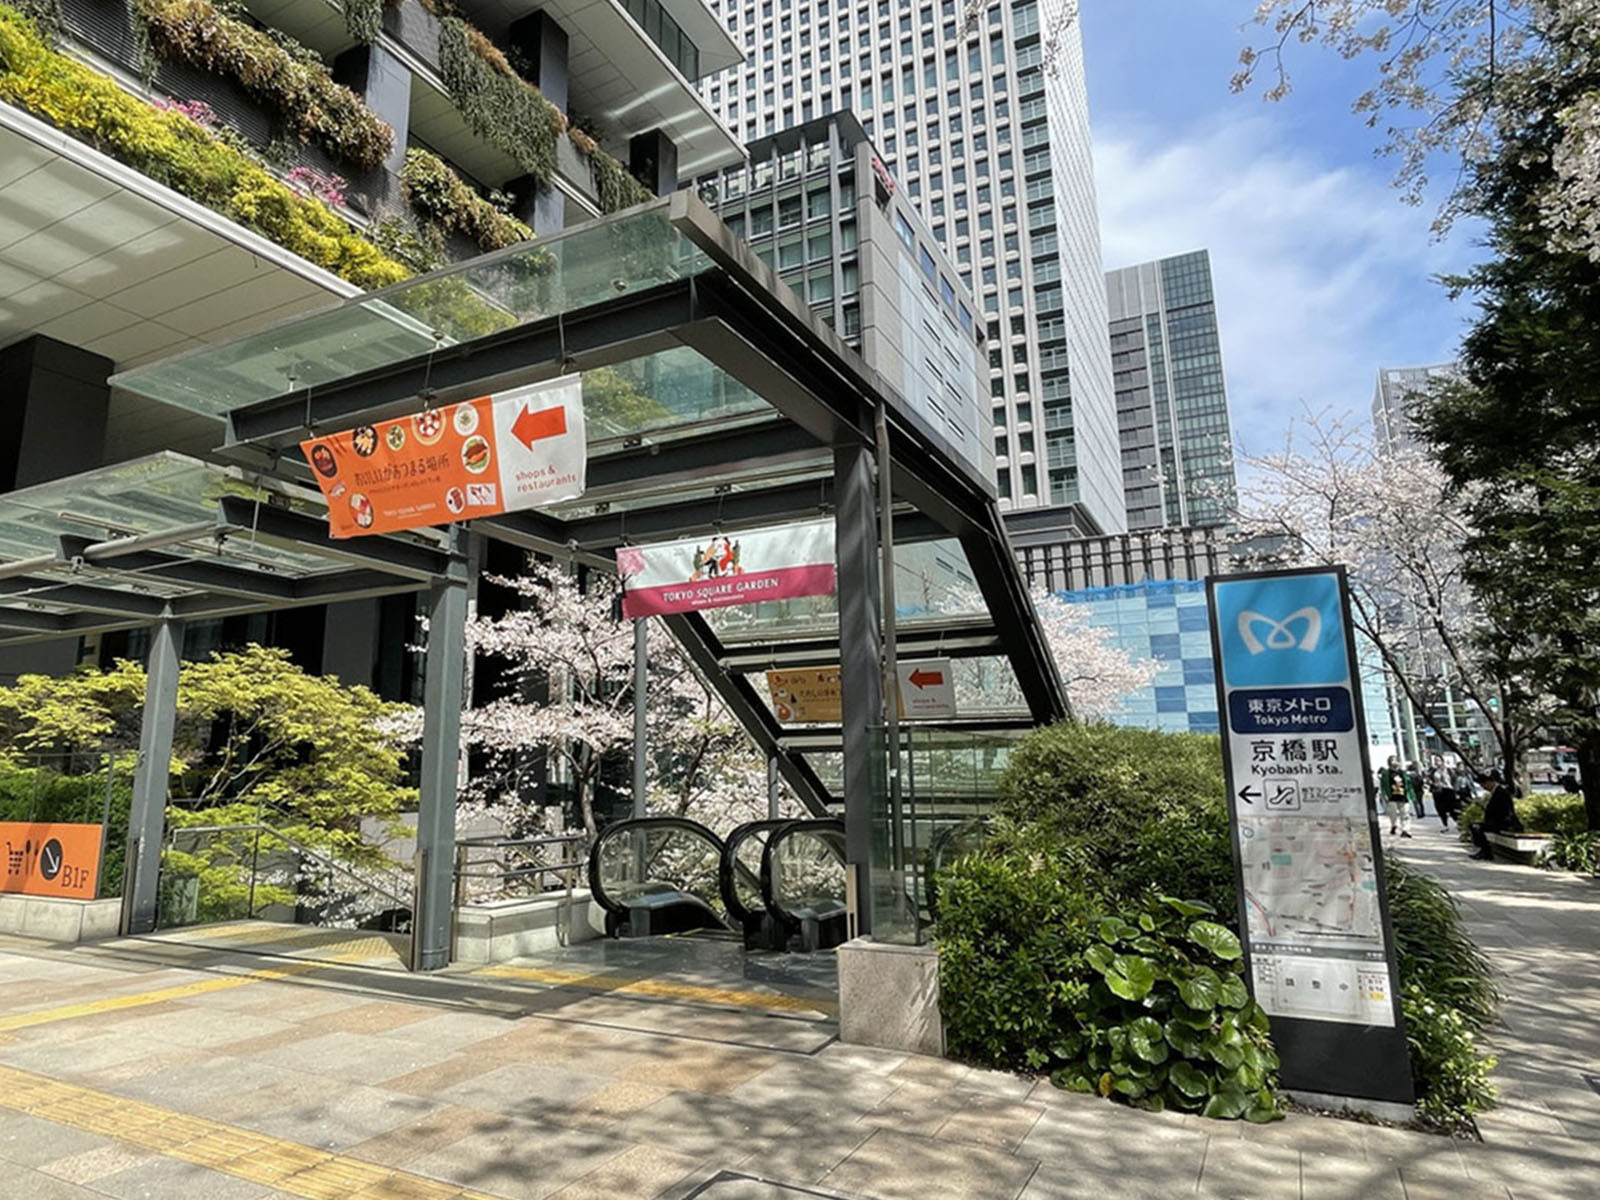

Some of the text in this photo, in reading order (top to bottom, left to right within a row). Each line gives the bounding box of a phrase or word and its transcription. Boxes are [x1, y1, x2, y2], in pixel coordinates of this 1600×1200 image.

[515, 464, 556, 481] shops &
[516, 474, 577, 493] restaurants
[663, 590, 694, 602] TOKYO
[696, 583, 733, 599] SQUARE
[736, 577, 779, 593] GARDEN
[1248, 697, 1331, 713] 東京メトロ
[1254, 713, 1328, 726] Tokyo Metro
[1250, 738, 1339, 762] 京橋駅
[1251, 763, 1343, 777] Kyobashi Sta.
[61, 864, 90, 889] B1F
